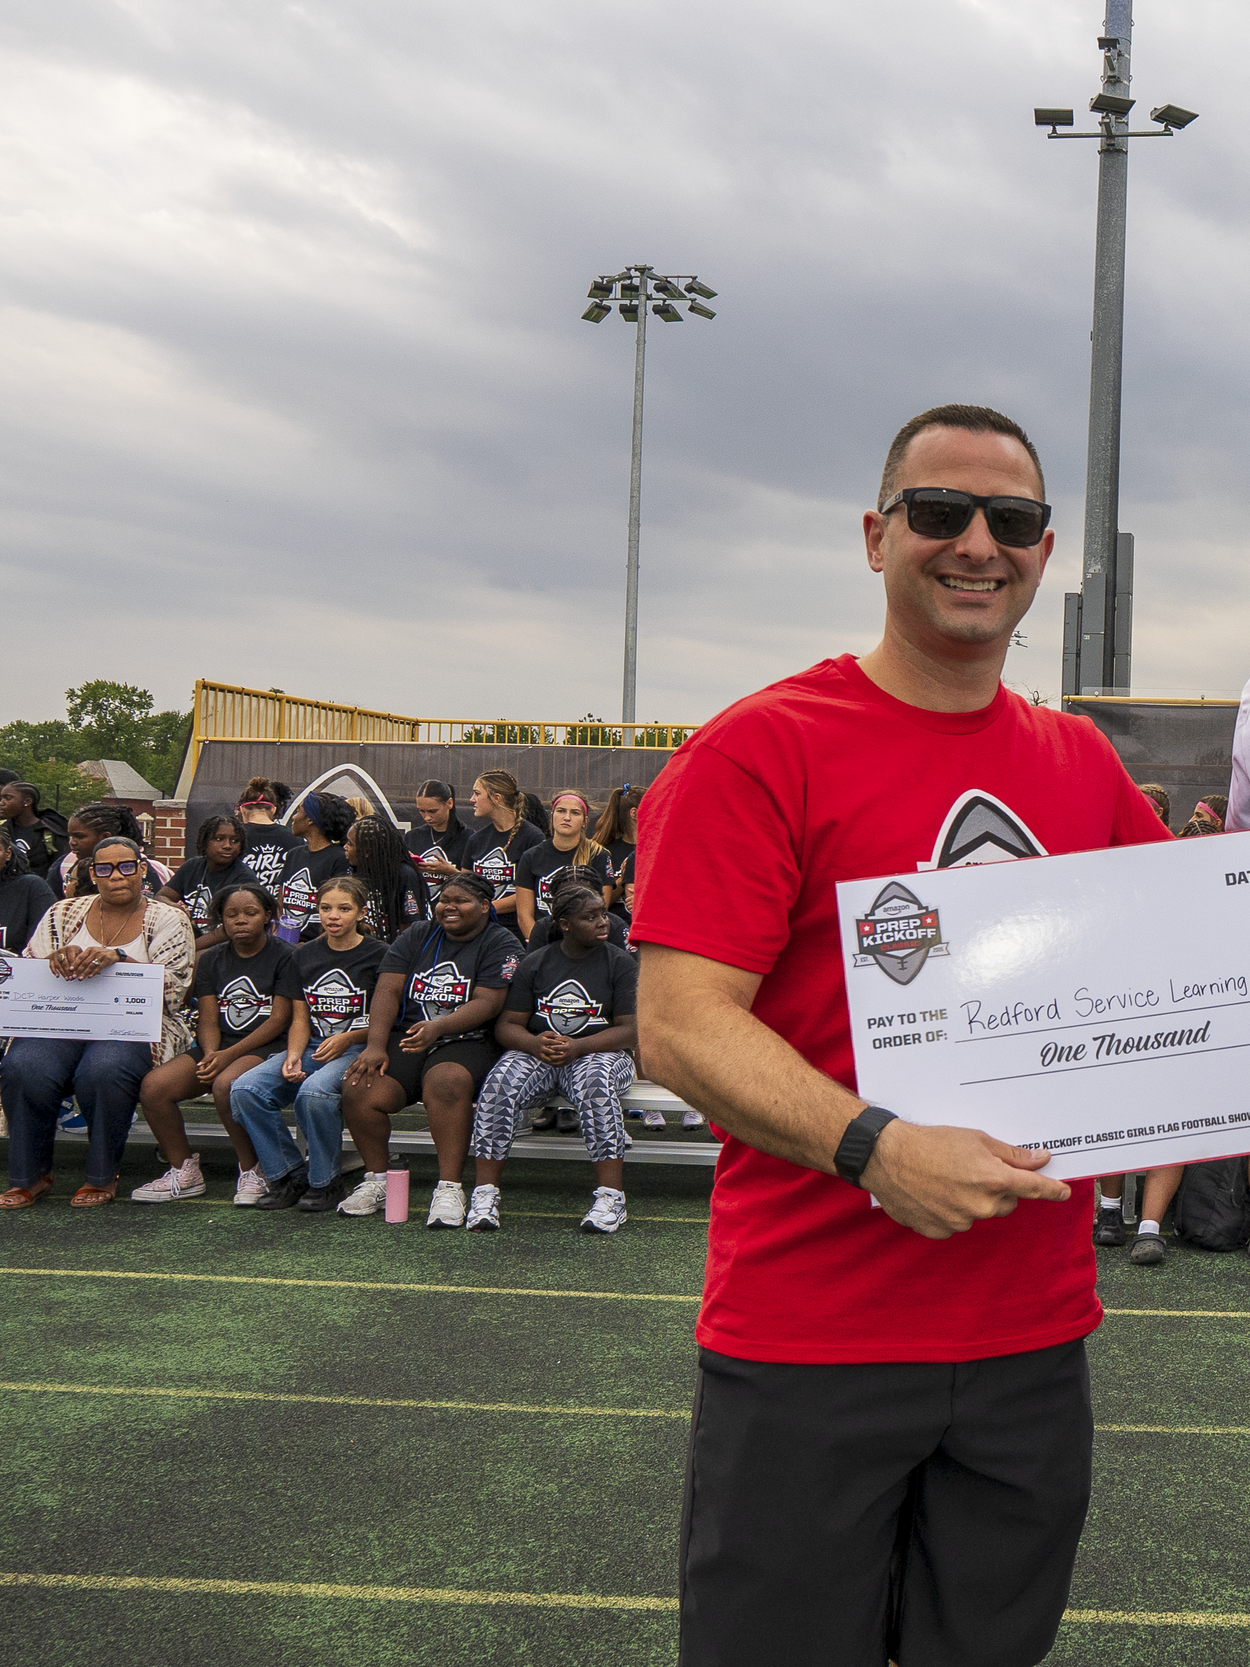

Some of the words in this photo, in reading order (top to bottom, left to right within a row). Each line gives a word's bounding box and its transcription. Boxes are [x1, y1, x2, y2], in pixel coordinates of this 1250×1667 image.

[289, 890, 309, 900] PREP
[283, 897, 317, 909] KICKOFF
[883, 903, 910, 914] amazon
[875, 918, 921, 934] PREP
[862, 928, 937, 948] KICKOFF
[880, 940, 921, 951] CLASSIC
[125, 997, 146, 1005] 1,000
[317, 997, 350, 1005] PREP
[413, 992, 463, 1003] KICKOFF
[310, 1004, 361, 1014] KICKOFF
[960, 999, 1062, 1034] Redford
[1074, 986, 1160, 1018] Service
[1169, 975, 1248, 1003] Learning
[867, 1014, 895, 1030] PAY
[897, 1012, 916, 1025] TO
[919, 1008, 948, 1023] THE
[872, 1031, 922, 1050] ORDER
[925, 1029, 948, 1042] OF:
[1040, 1041, 1087, 1067] One
[1091, 1020, 1211, 1060] Thousand
[1042, 1136, 1083, 1150] KICKOFF
[1084, 1130, 1125, 1144] CLASSIC
[1127, 1126, 1156, 1139] GIRLS
[1157, 1122, 1180, 1135] FLAG
[1181, 1114, 1227, 1130] FOOTBALL
